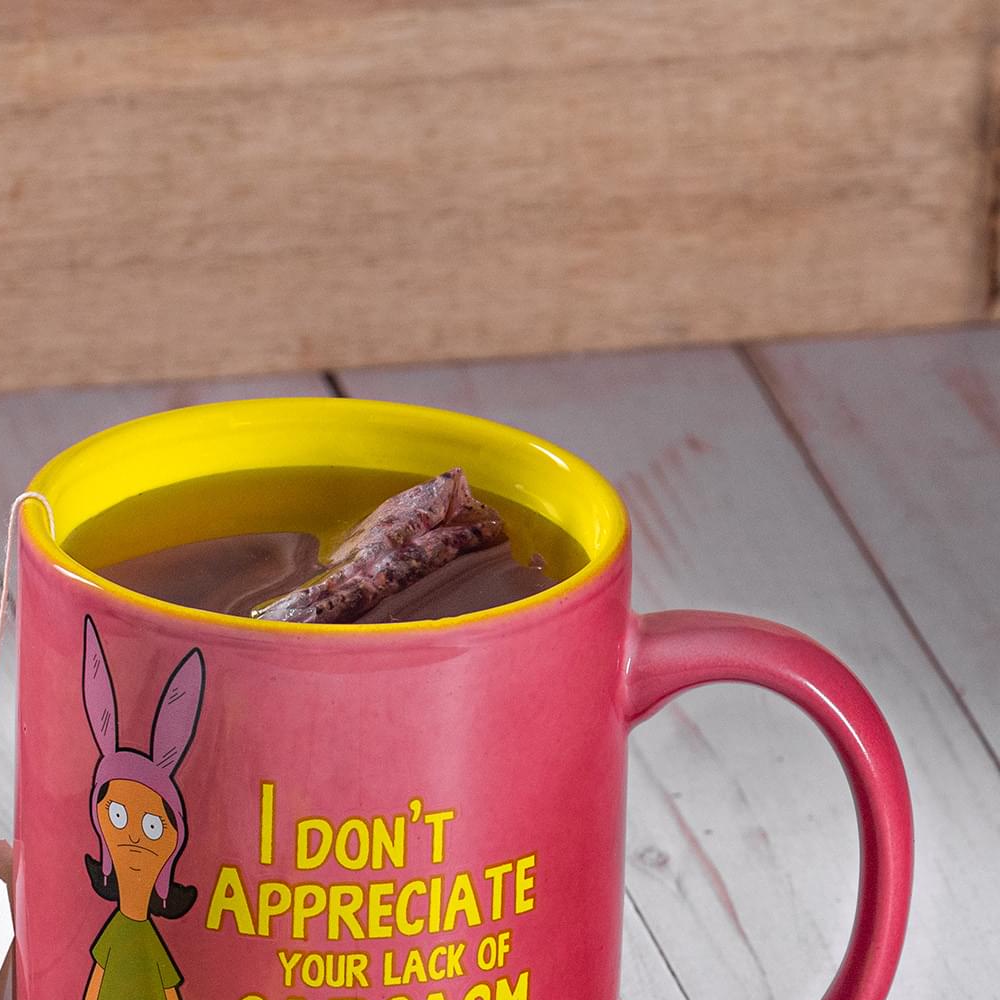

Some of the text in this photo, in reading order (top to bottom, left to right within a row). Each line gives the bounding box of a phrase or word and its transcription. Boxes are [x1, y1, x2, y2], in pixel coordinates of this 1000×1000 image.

[260, 782, 455, 871] I DON'T
[205, 854, 537, 941] APPRECIATE
[277, 931, 511, 988] YOUR LACK OF
